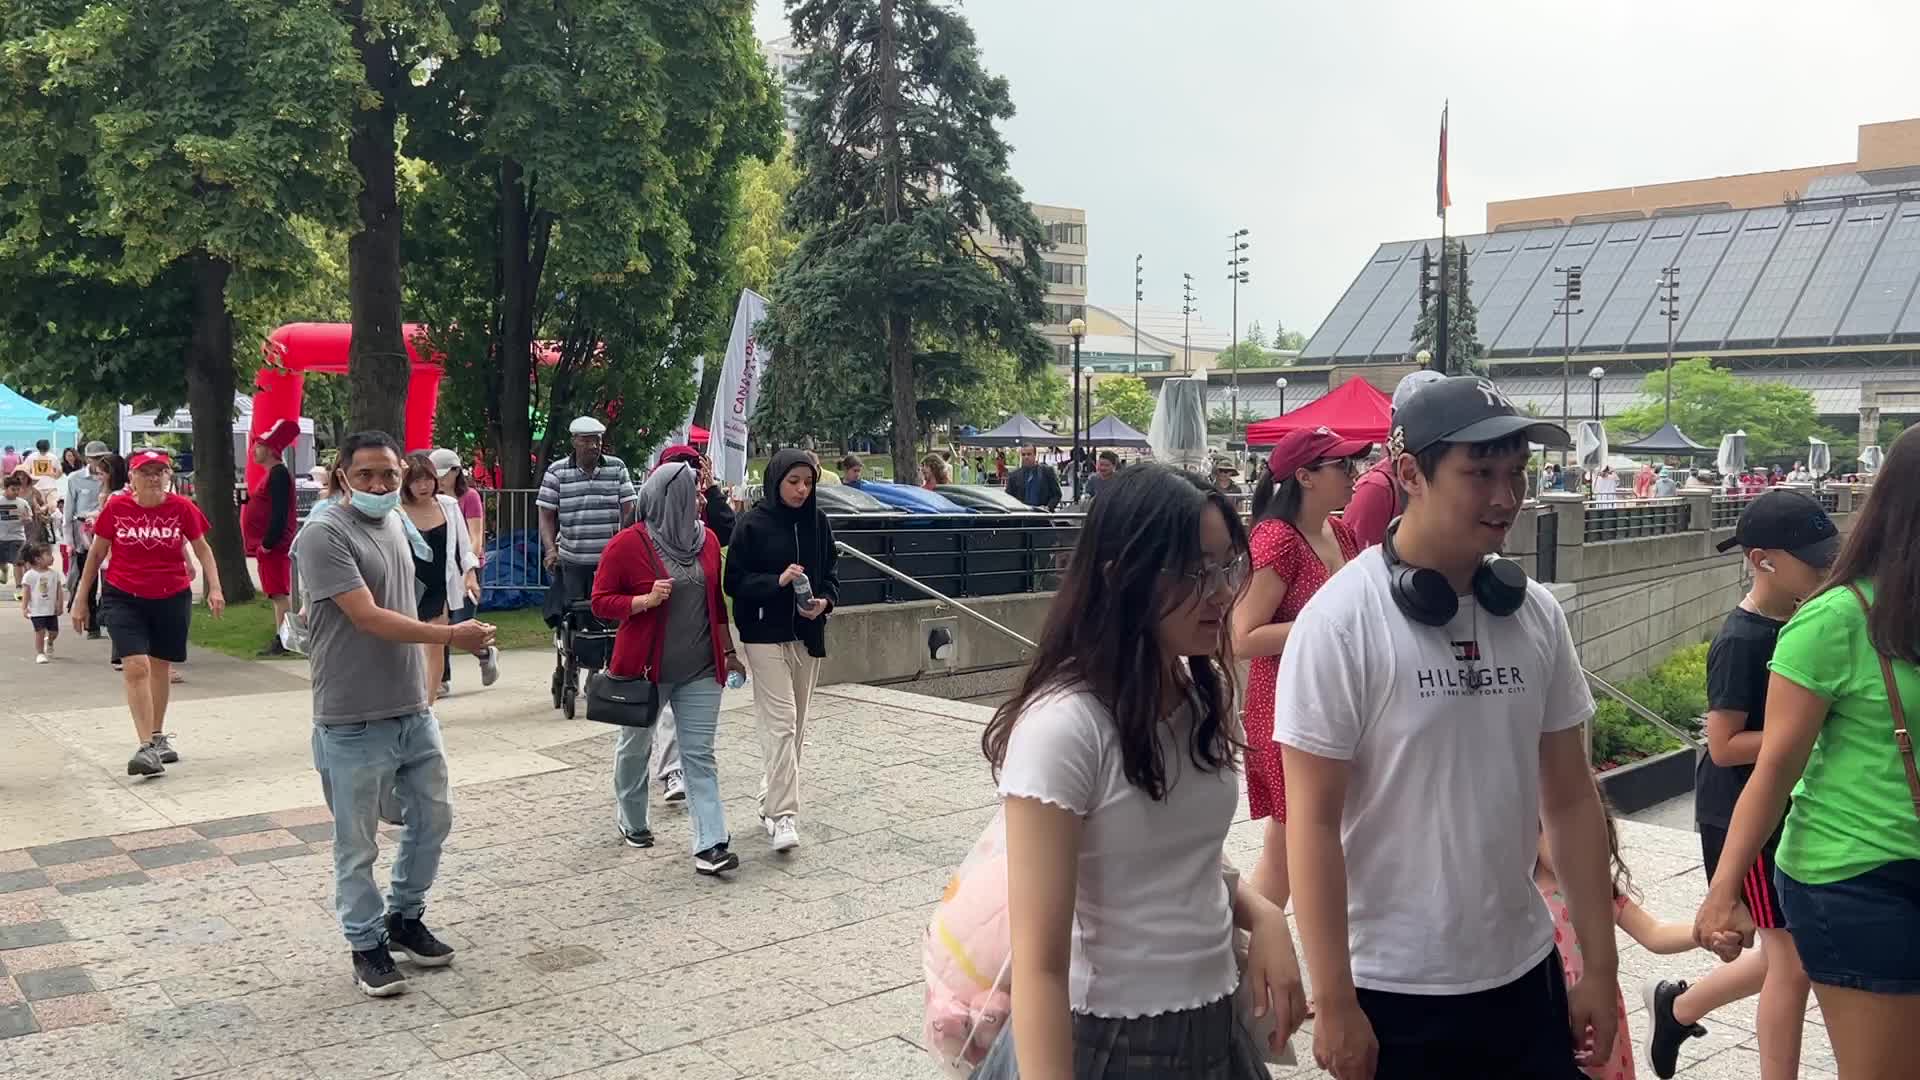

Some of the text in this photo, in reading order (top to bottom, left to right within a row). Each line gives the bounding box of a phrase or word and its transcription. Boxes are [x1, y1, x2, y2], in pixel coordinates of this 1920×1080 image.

[1476, 379, 1514, 407] NY
[116, 527, 180, 538] CANADA
[1417, 667, 1524, 689] HILFGER
[1479, 688, 1504, 696] YORK
